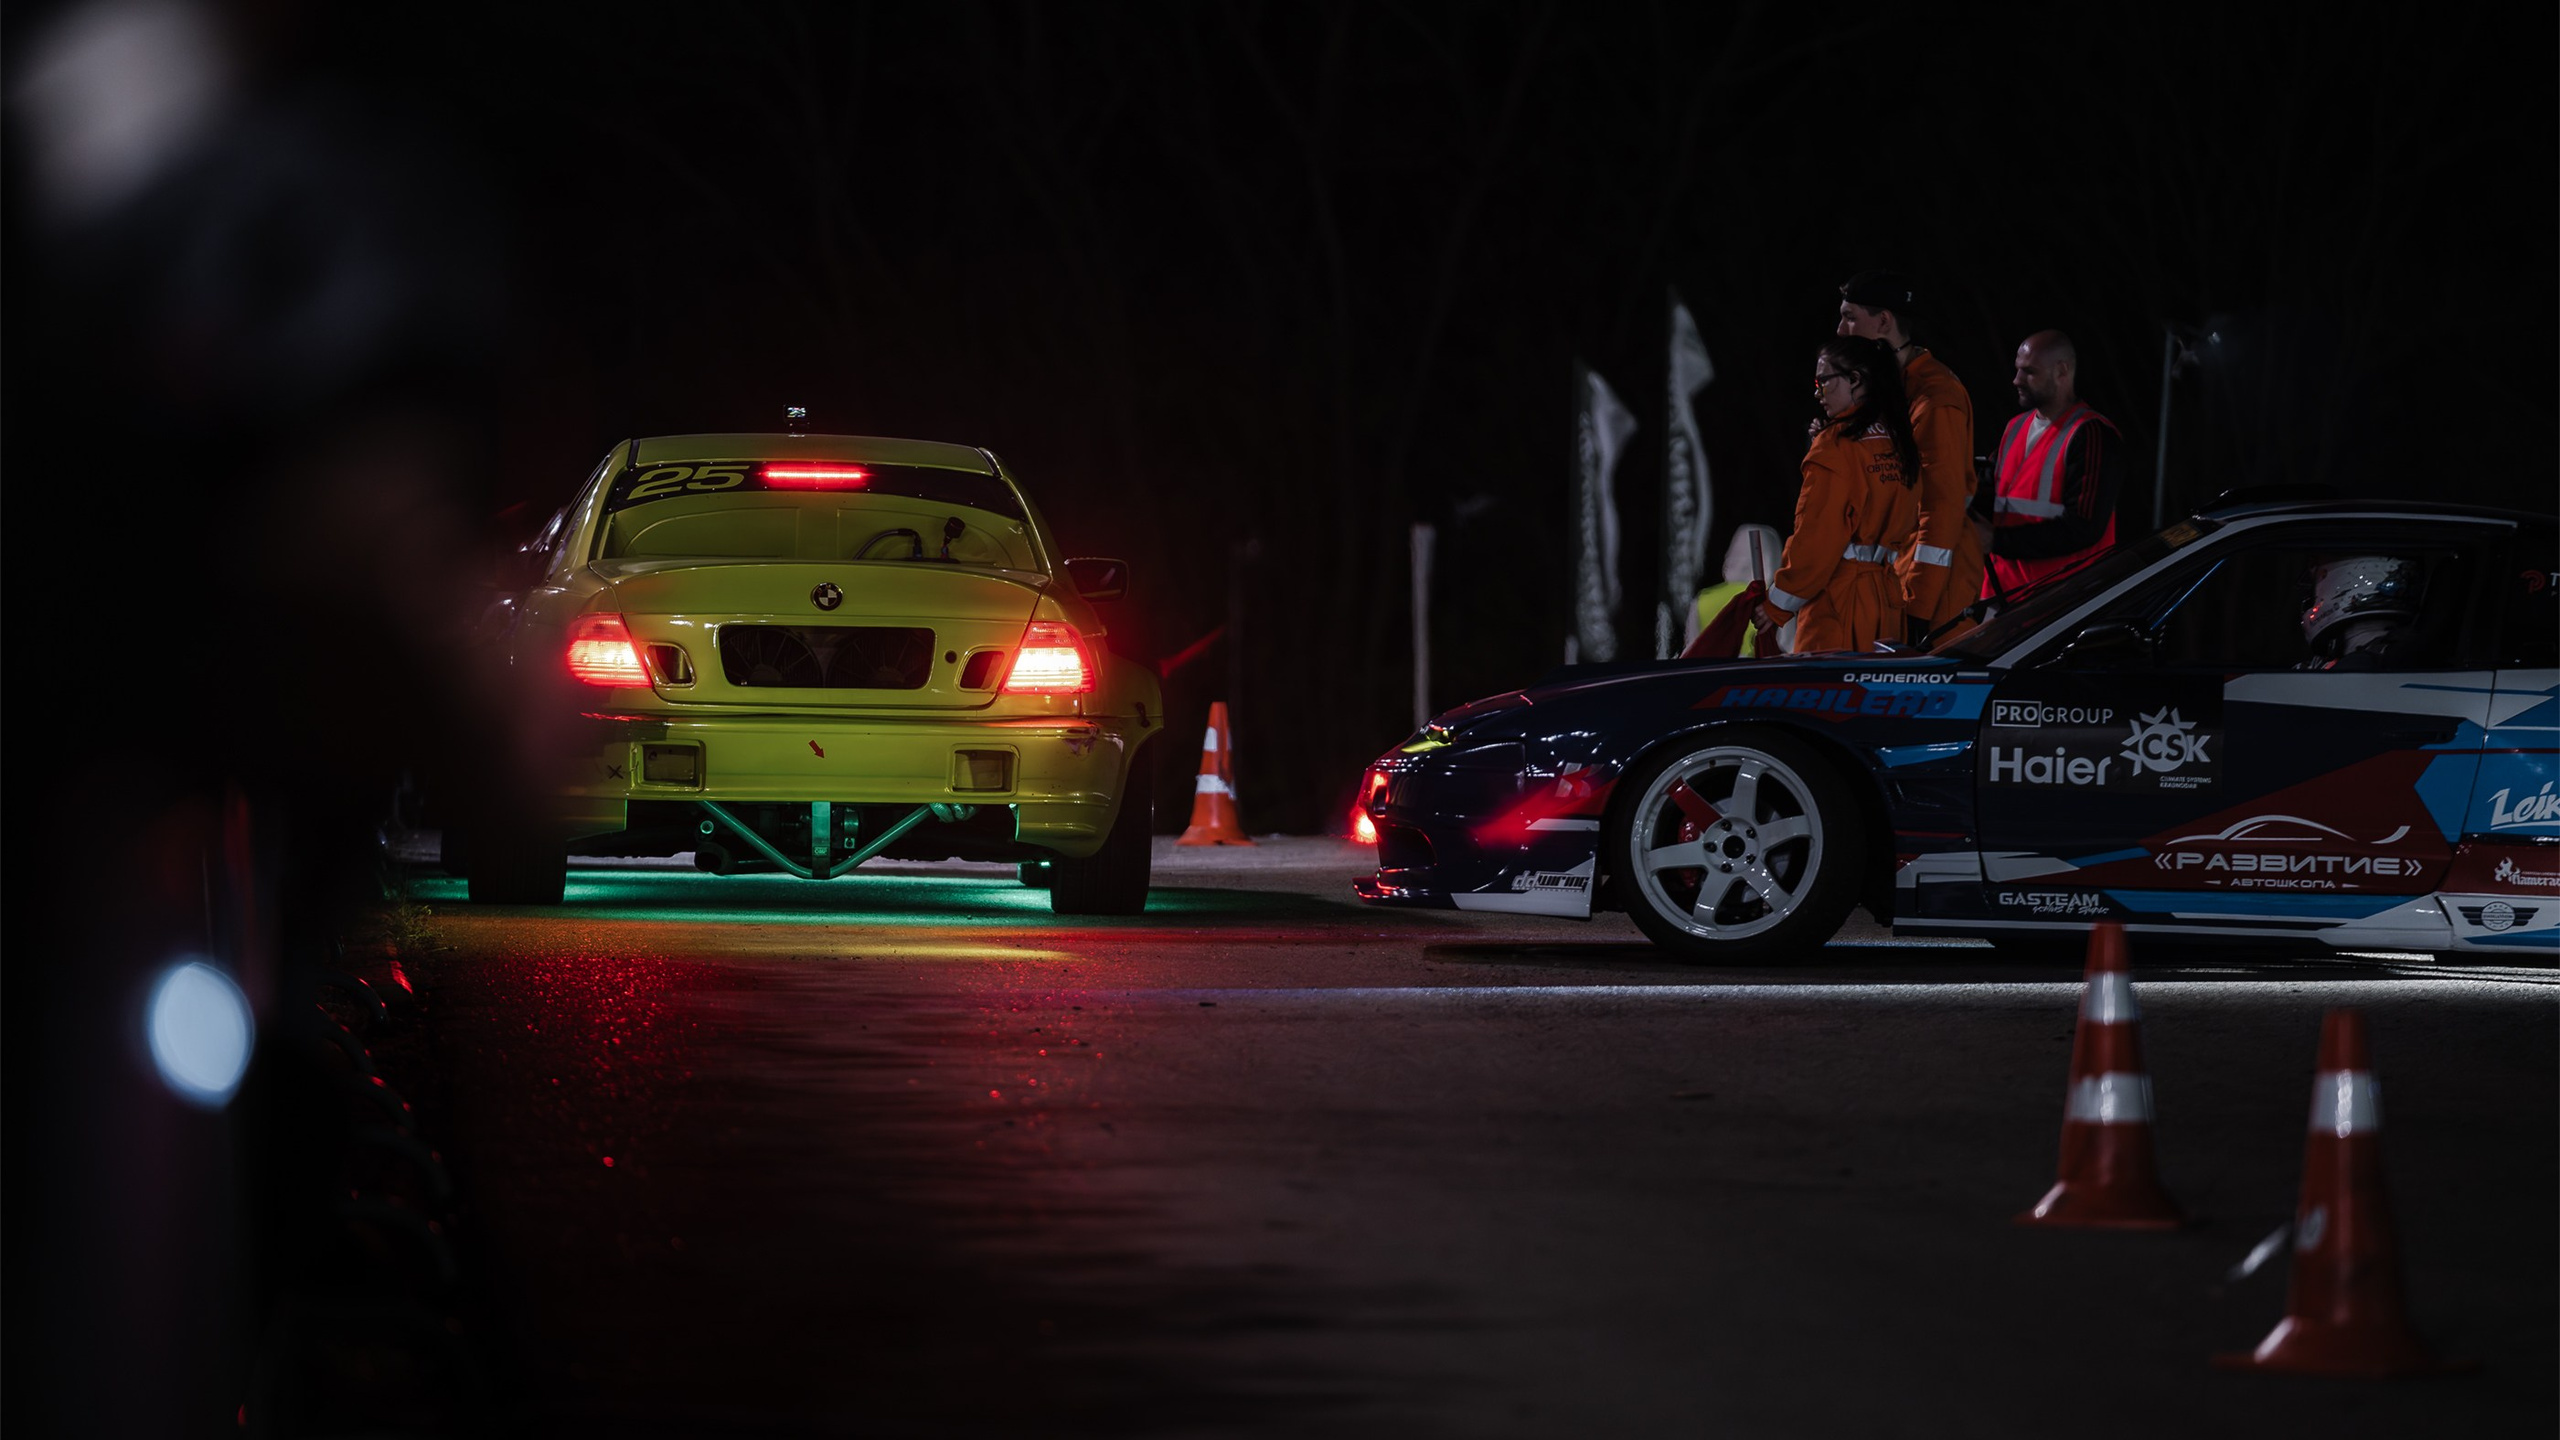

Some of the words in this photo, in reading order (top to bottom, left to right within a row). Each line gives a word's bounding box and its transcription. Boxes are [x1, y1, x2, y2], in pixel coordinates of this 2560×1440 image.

[627, 465, 750, 500] 25
[1720, 687, 1958, 716] HABILEAD
[1989, 746, 2112, 786] Haier
[2154, 852, 2423, 877] «РАЗВИТИЕ»
[2230, 877, 2337, 889] АВТОШКОЛА
[1999, 892, 2100, 907] GASTEAM
